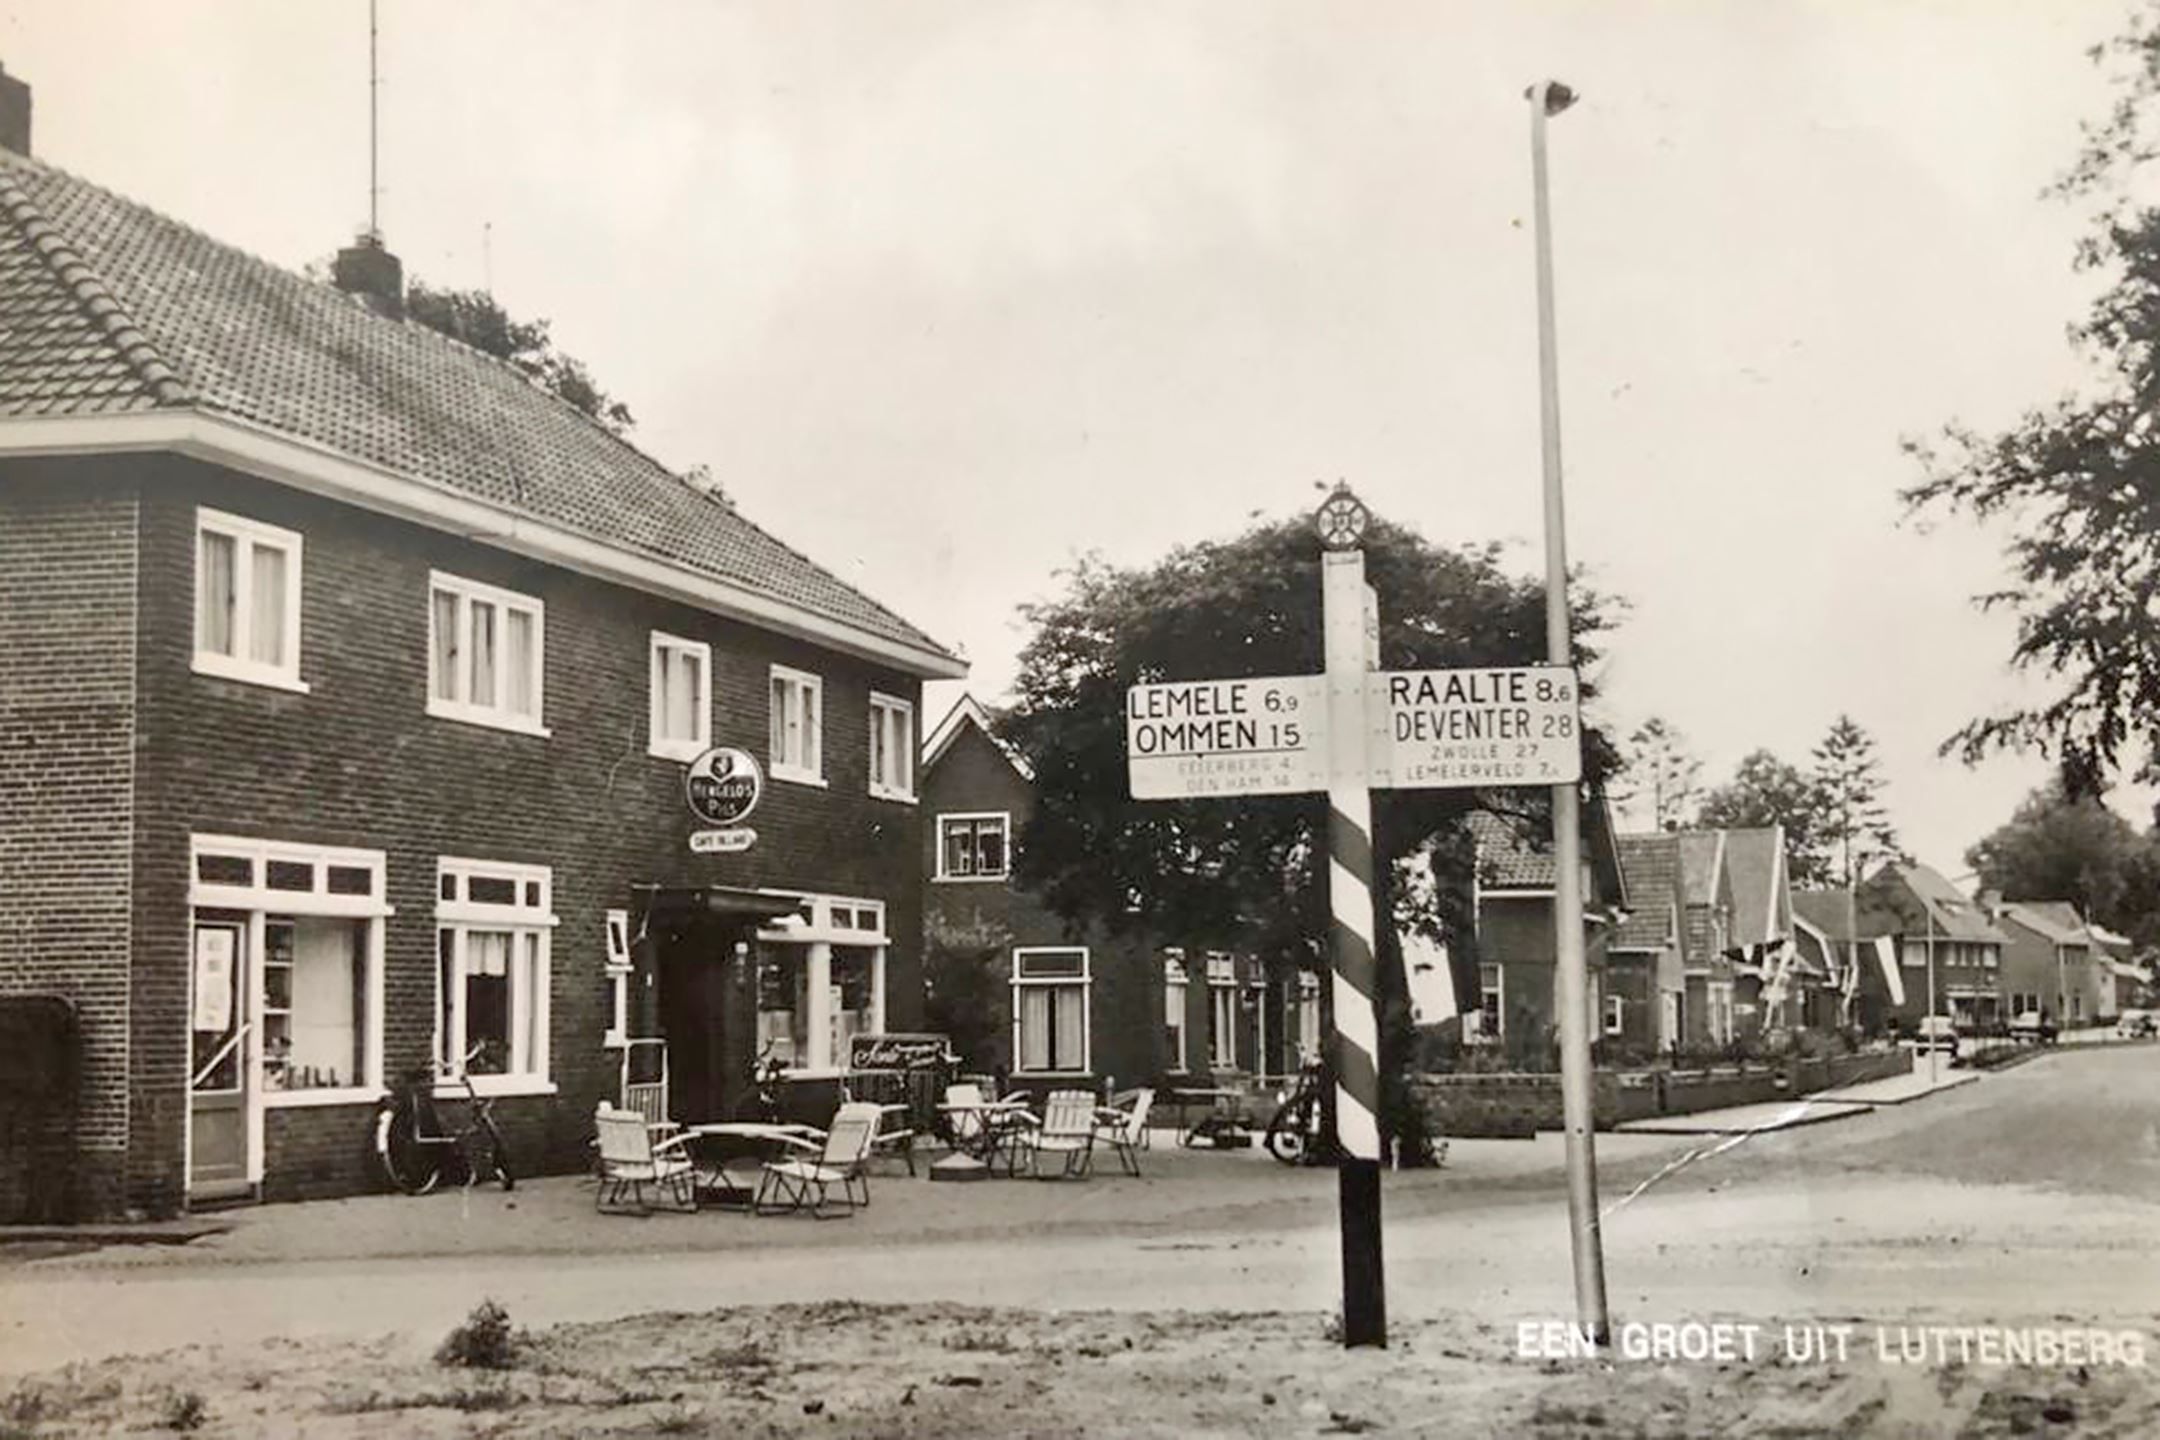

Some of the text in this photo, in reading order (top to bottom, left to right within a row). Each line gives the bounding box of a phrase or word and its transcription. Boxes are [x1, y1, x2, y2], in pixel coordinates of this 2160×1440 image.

[1131, 684, 1249, 719] LEMELE
[1389, 672, 1529, 706] RAALTE
[1135, 719, 1302, 753] OMMEN 15
[1394, 708, 1574, 742] DEVENTER 28
[1430, 742, 1540, 761] ZWOLLE 27
[1405, 762, 1526, 781] LEMELERVELD
